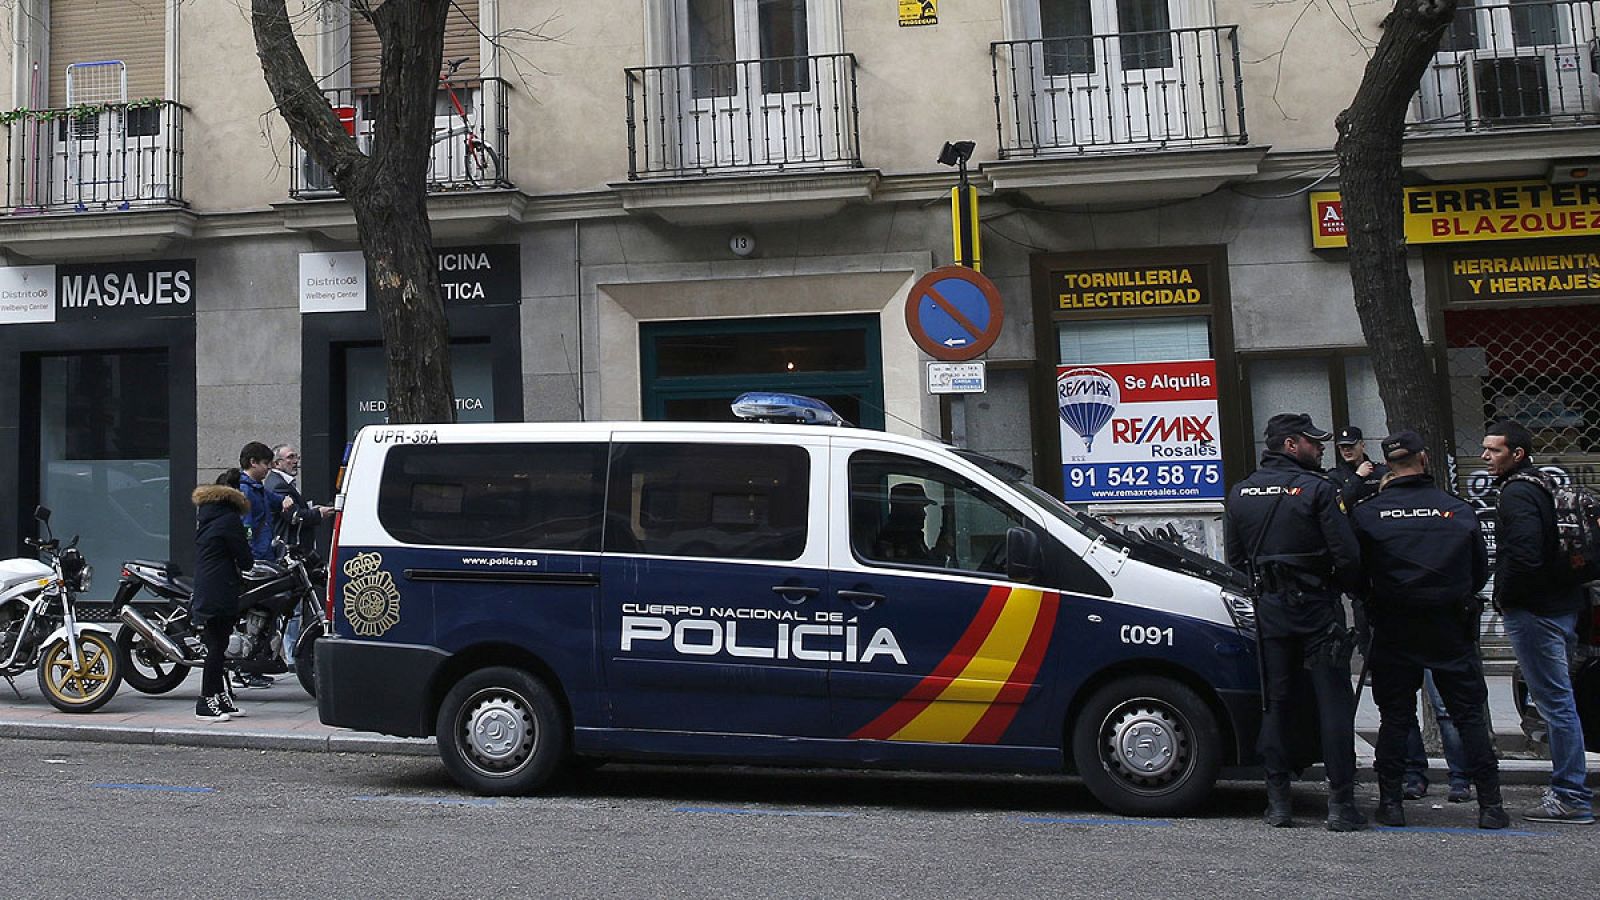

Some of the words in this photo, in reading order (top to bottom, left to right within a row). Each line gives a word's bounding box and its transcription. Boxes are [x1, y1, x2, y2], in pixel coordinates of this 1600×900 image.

[735, 238, 747, 249] 13
[438, 252, 491, 271] ICINA
[1453, 254, 1600, 275] HERRAMIENTA
[307, 276, 358, 286] Distrito08
[1064, 269, 1193, 289] TORNILLERIA
[1468, 279, 1483, 295] Y
[1490, 273, 1600, 294] HERRAJES
[62, 270, 190, 308] MASAJES
[337, 290, 358, 298] Center
[440, 282, 485, 300] TICA
[1059, 288, 1201, 309] ELECTRICIDAD
[1059, 379, 1112, 399] RE/MAX
[1124, 376, 1146, 389] Se
[1151, 373, 1211, 391] Alquila
[374, 430, 439, 444] UPR-36A
[1111, 415, 1215, 445] RE/MAX
[1151, 444, 1217, 458] Rosales
[1070, 467, 1097, 488] 91
[1107, 466, 1150, 487] 542
[1156, 464, 1185, 486] 58
[1190, 463, 1220, 484] 75
[1091, 487, 1200, 498] www.remaxrosales.com
[1380, 508, 1441, 520] POLICIA
[462, 557, 538, 566] www.policia.es
[621, 603, 704, 617] CUERPO
[709, 606, 808, 622] NACIONAL
[814, 611, 844, 623] DE
[620, 615, 909, 666] POLICÍA
